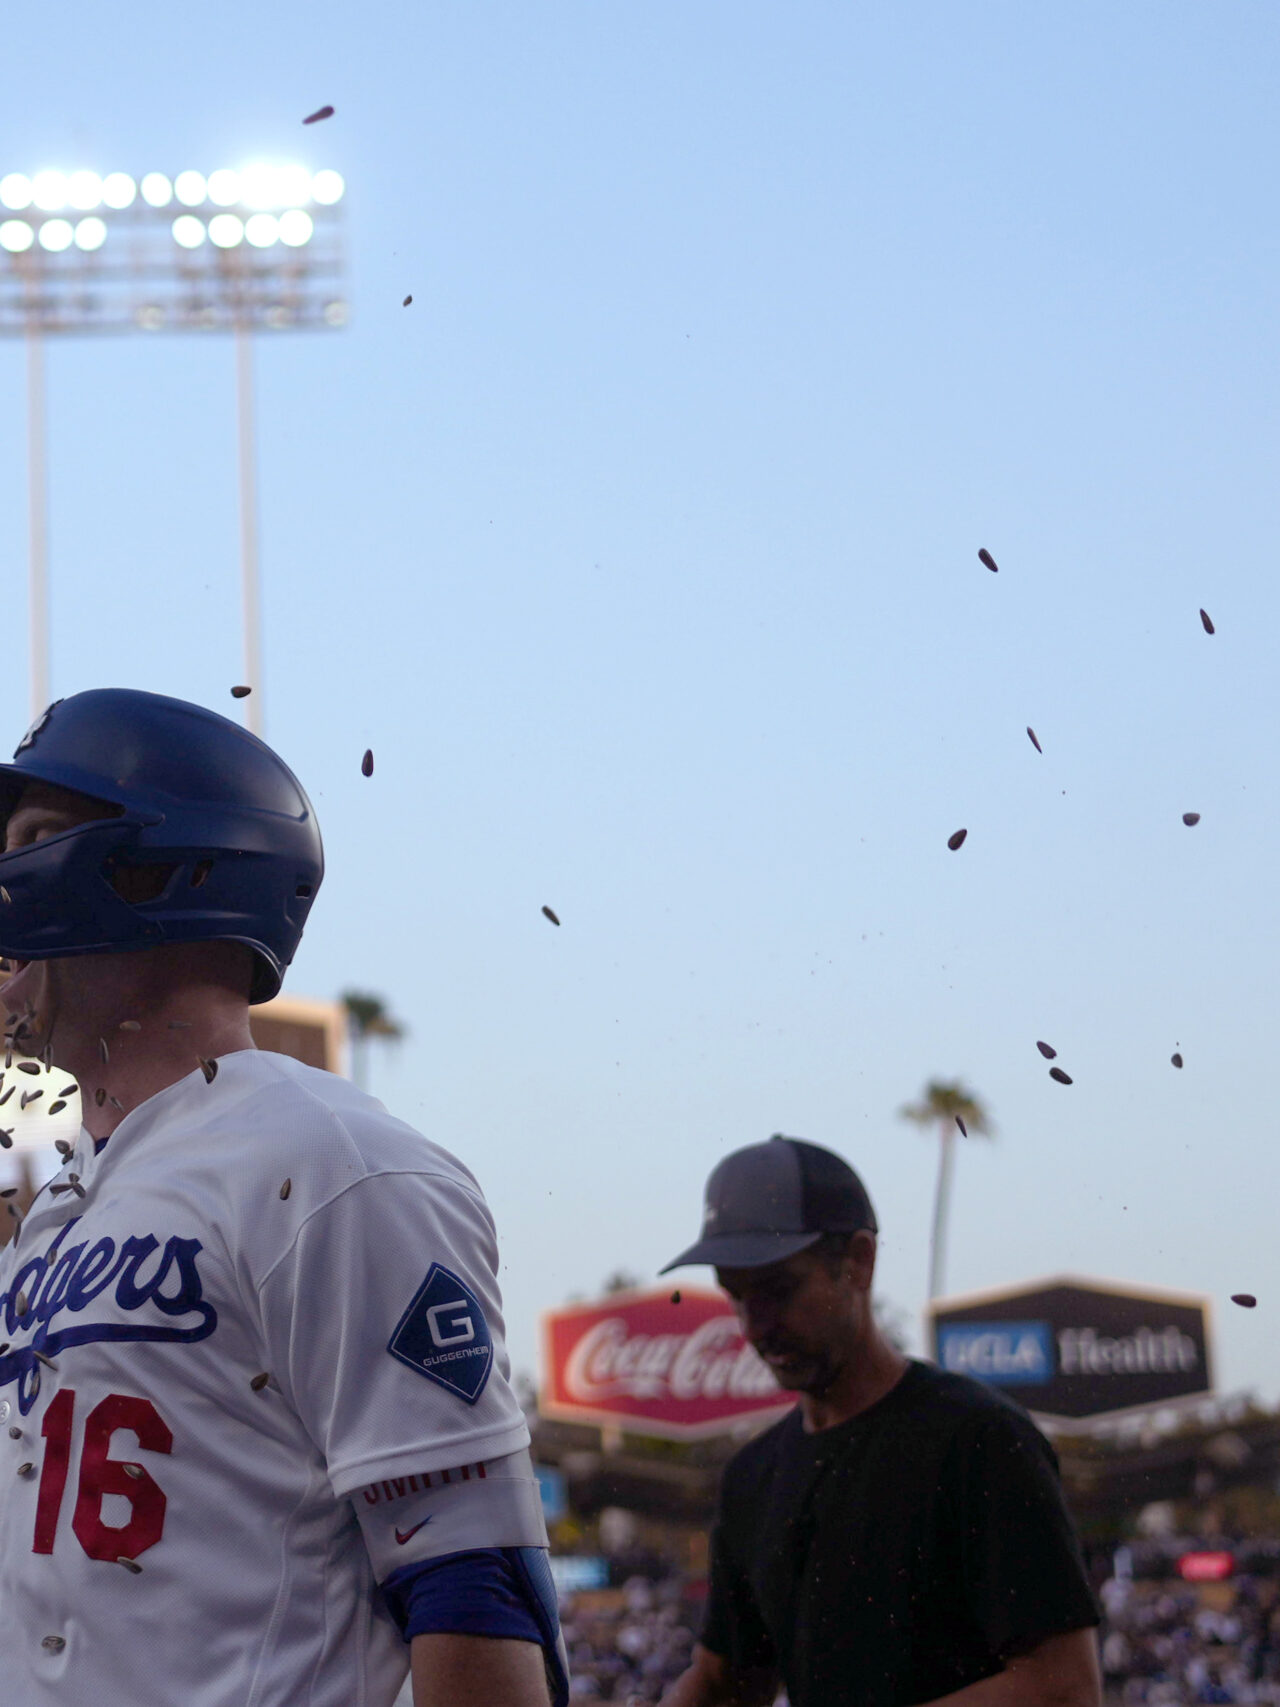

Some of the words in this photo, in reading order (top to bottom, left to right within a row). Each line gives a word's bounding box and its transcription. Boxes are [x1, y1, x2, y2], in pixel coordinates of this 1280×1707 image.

[426, 1299, 475, 1348] G
[945, 1334, 1044, 1372] UCLA
[1061, 1329, 1195, 1373] Health
[31, 1388, 174, 1563] 16
